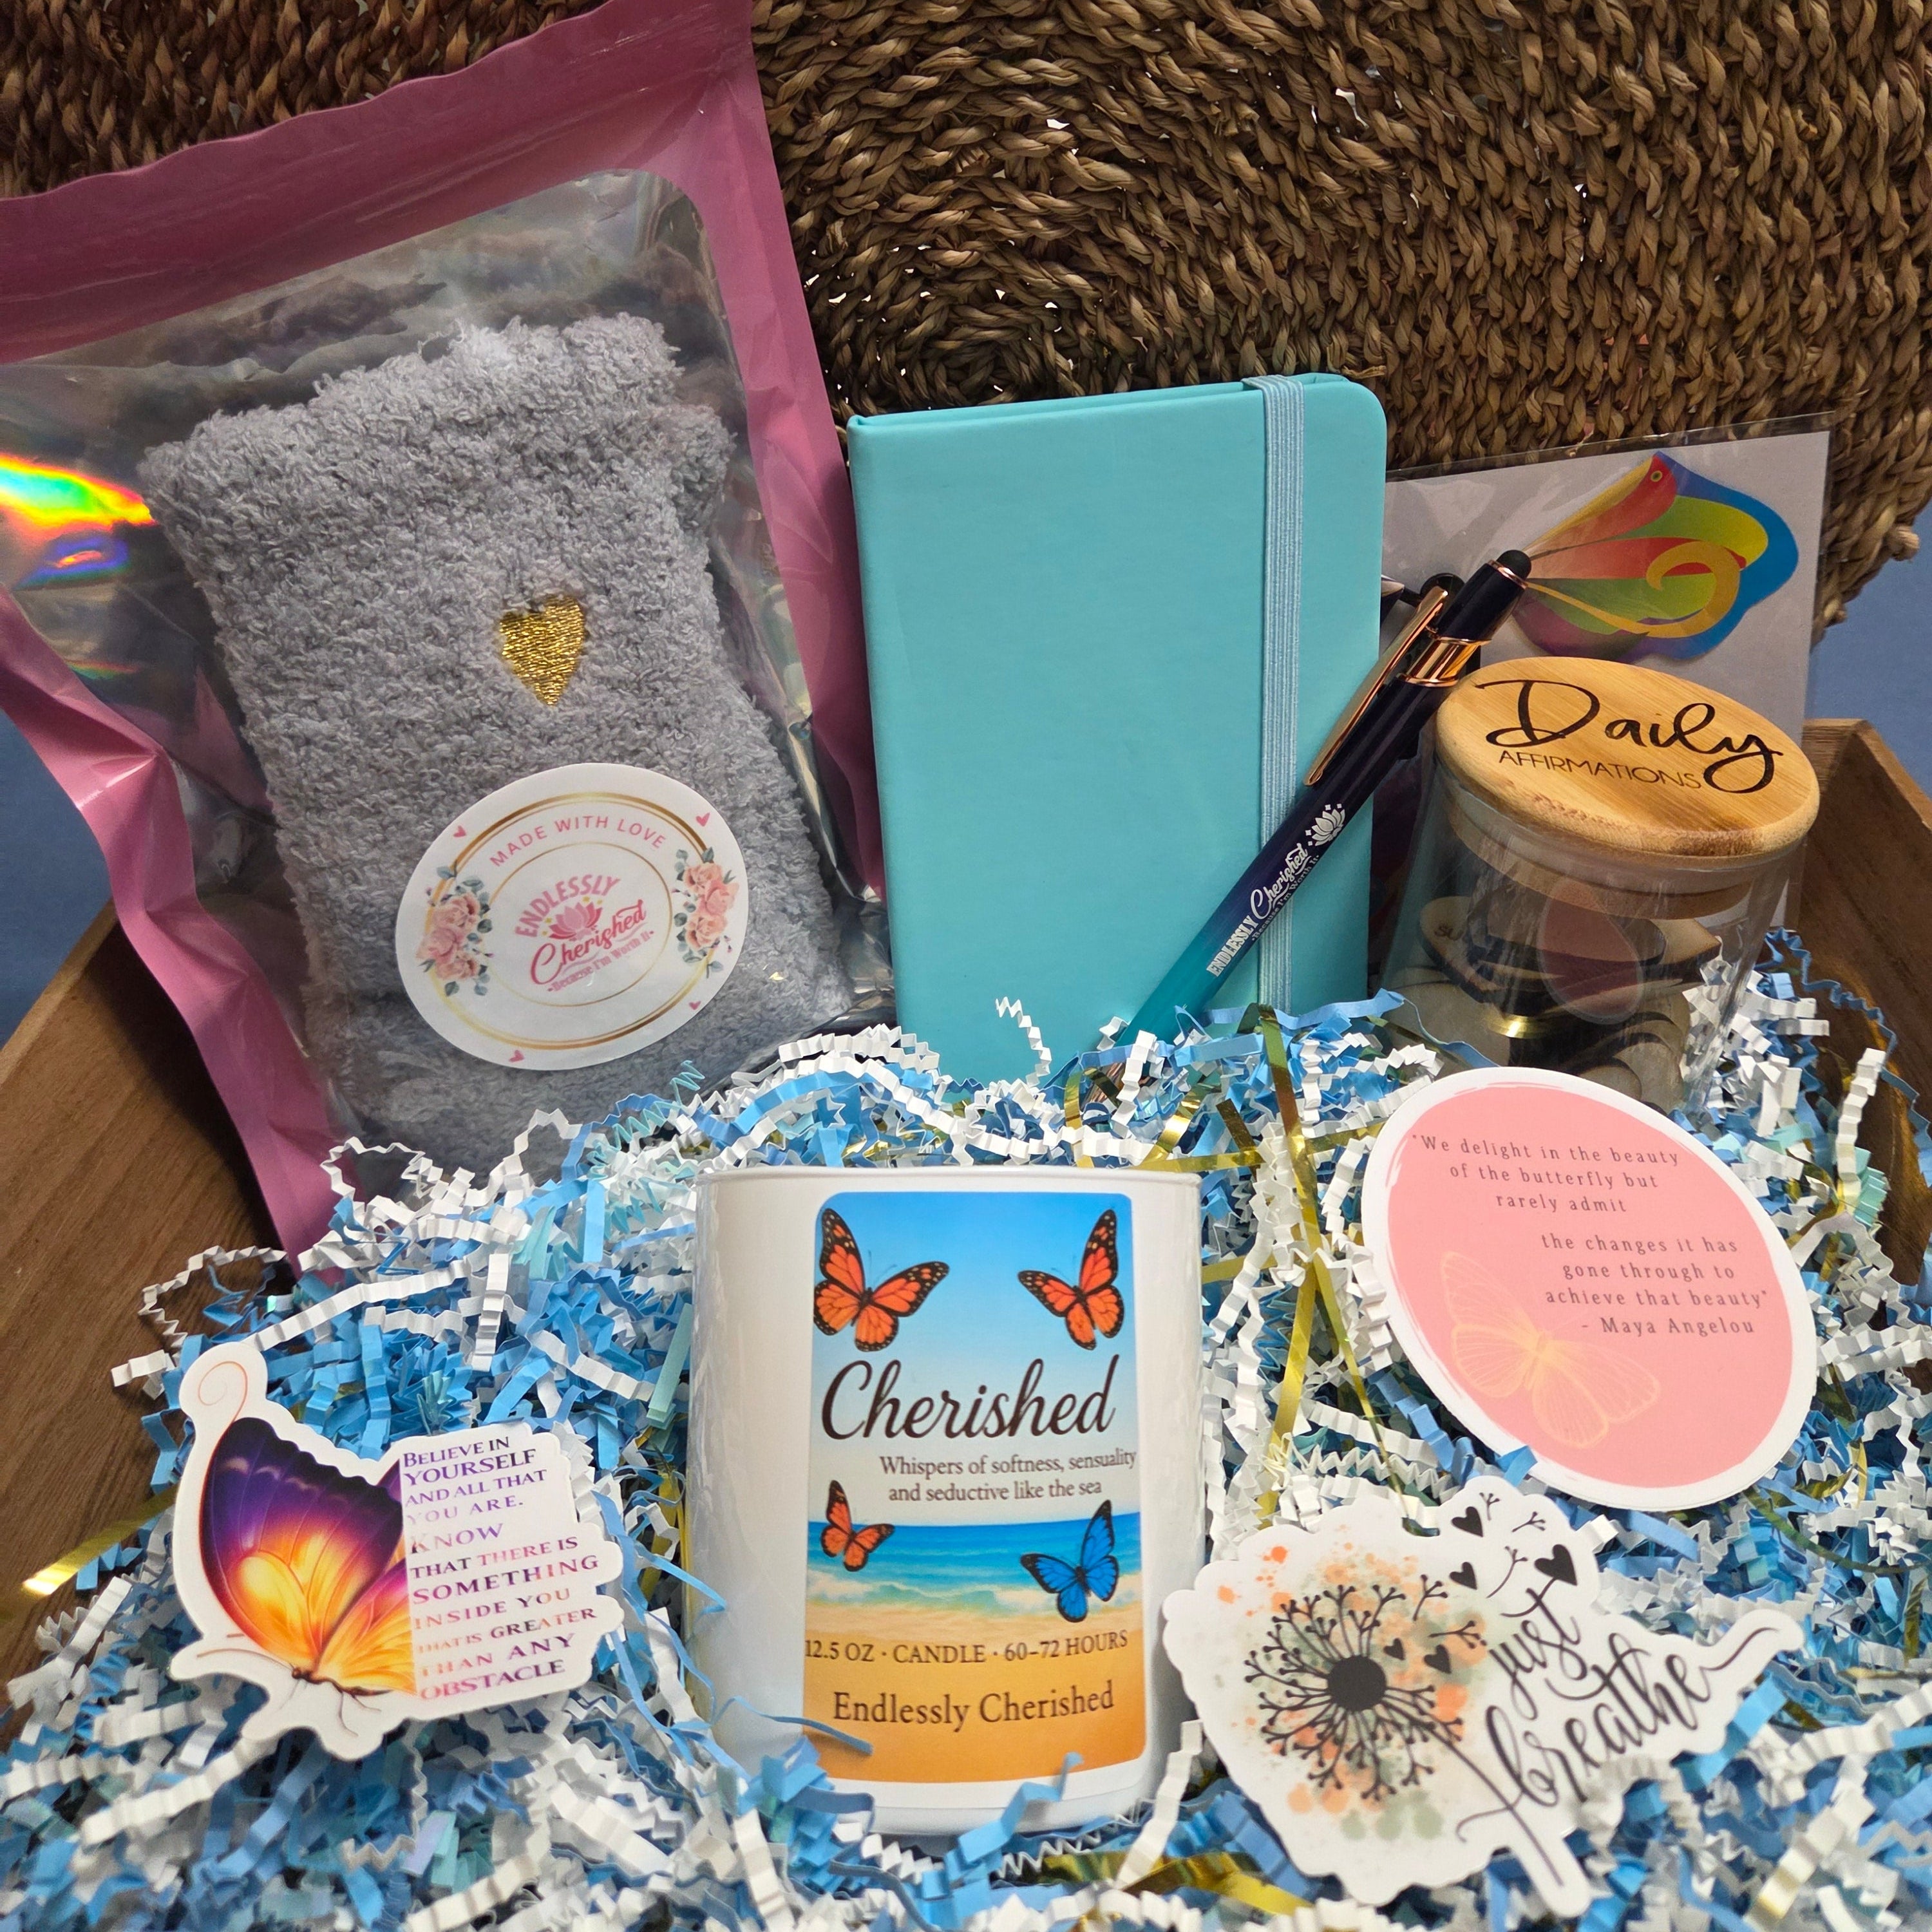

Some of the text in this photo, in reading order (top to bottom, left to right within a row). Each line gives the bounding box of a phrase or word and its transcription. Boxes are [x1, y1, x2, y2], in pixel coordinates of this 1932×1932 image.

[1475, 679, 1784, 793] Daily
[1499, 750, 1701, 789] AFFIRMATIONS
[490, 815, 666, 867] MADE WITH LOVE
[515, 874, 621, 938] ENDLESSLY
[1206, 843, 1308, 978] ENDLESSLY Cherished
[530, 899, 647, 985] Cherished
[1461, 1139, 1532, 1160] delight
[1540, 1146, 1560, 1160] in
[1570, 1146, 1602, 1162] the
[1610, 1147, 1678, 1166] beauty
[1450, 1164, 1659, 1190] of the butterfly but
[1496, 1193, 1627, 1212] rarely admit
[1542, 1233, 1738, 1255] the changes it has
[1563, 1262, 1735, 1282] gone through to
[1546, 1287, 1626, 1305] achieve
[1636, 1289, 1681, 1306] that
[1600, 1317, 1656, 1337] Maya
[1669, 1317, 1754, 1337] Angelou
[821, 1354, 1120, 1440] Cherished
[489, 1436, 509, 1452] IN
[403, 1448, 536, 1486] YOURSELF
[880, 1448, 1137, 1479] Whispers of softness, sensuality
[405, 1469, 548, 1507] AND ALL THAT
[889, 1479, 1102, 1501] and seductive like the sea
[407, 1494, 524, 1524] YOU ARE.
[410, 1522, 503, 1554] KNOW
[410, 1536, 578, 1578] THAT THERE IS
[413, 1555, 598, 1605] SOMETHING
[415, 1588, 571, 1629] INSIDE YOU
[466, 1633, 482, 1644] IS
[490, 1608, 598, 1639] GREATER
[507, 1633, 575, 1660] ANY
[805, 1640, 838, 1660] 12.5
[844, 1643, 875, 1662] OZ
[893, 1643, 985, 1663] CANDLE
[1065, 1629, 1128, 1656] HOURS
[1488, 1587, 1589, 1720] just
[421, 1659, 565, 1700] OBSTACLE
[833, 1679, 1115, 1732] Endlessly Cherished
[1455, 1629, 1780, 1842] breathe
